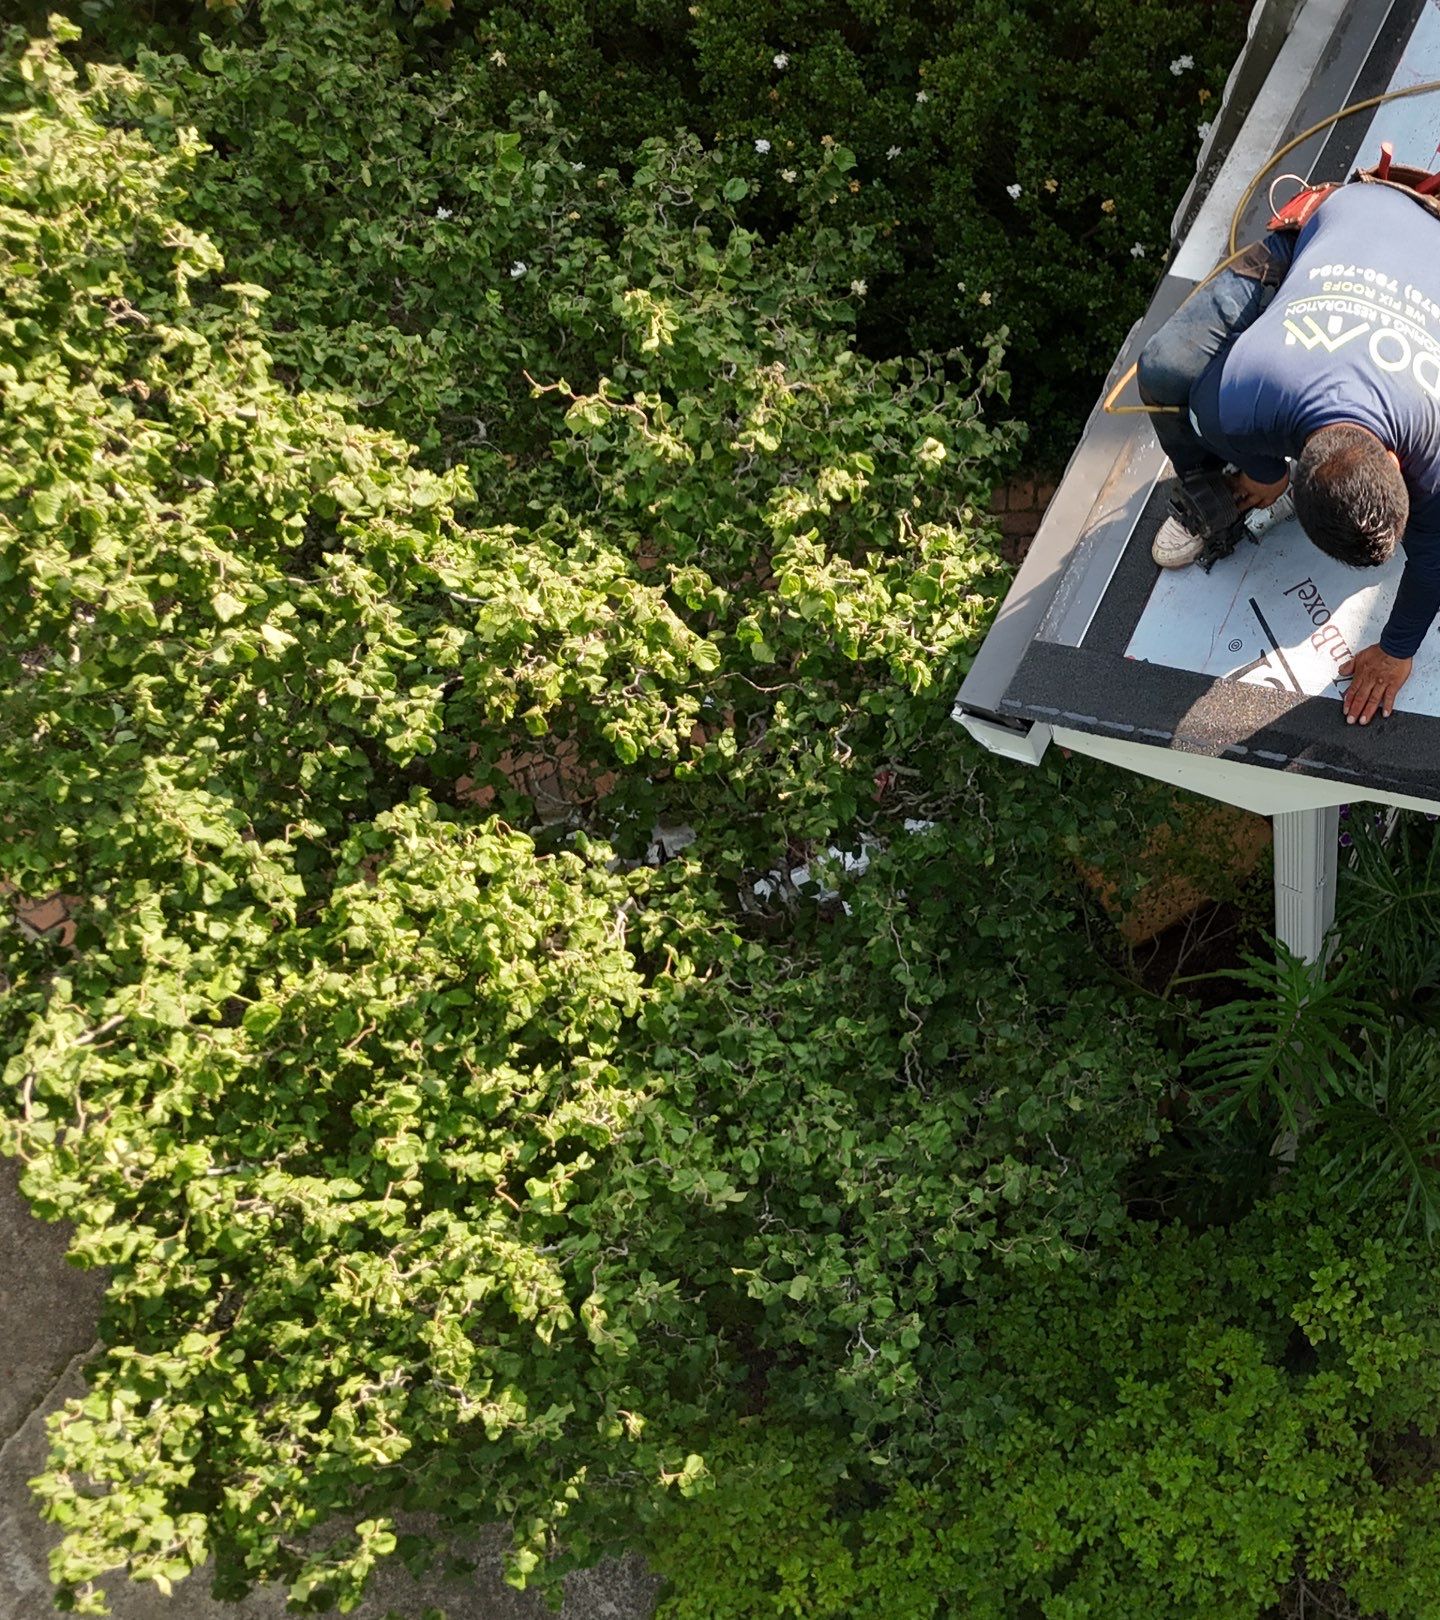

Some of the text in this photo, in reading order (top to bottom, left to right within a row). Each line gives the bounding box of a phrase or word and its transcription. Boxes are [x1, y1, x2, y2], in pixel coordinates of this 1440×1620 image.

[1284, 300, 1377, 322] RESTORATION
[1322, 281, 1427, 326] WE FIX ROOFS
[1380, 312, 1391, 326] &
[1283, 577, 1355, 700] nBoxel
